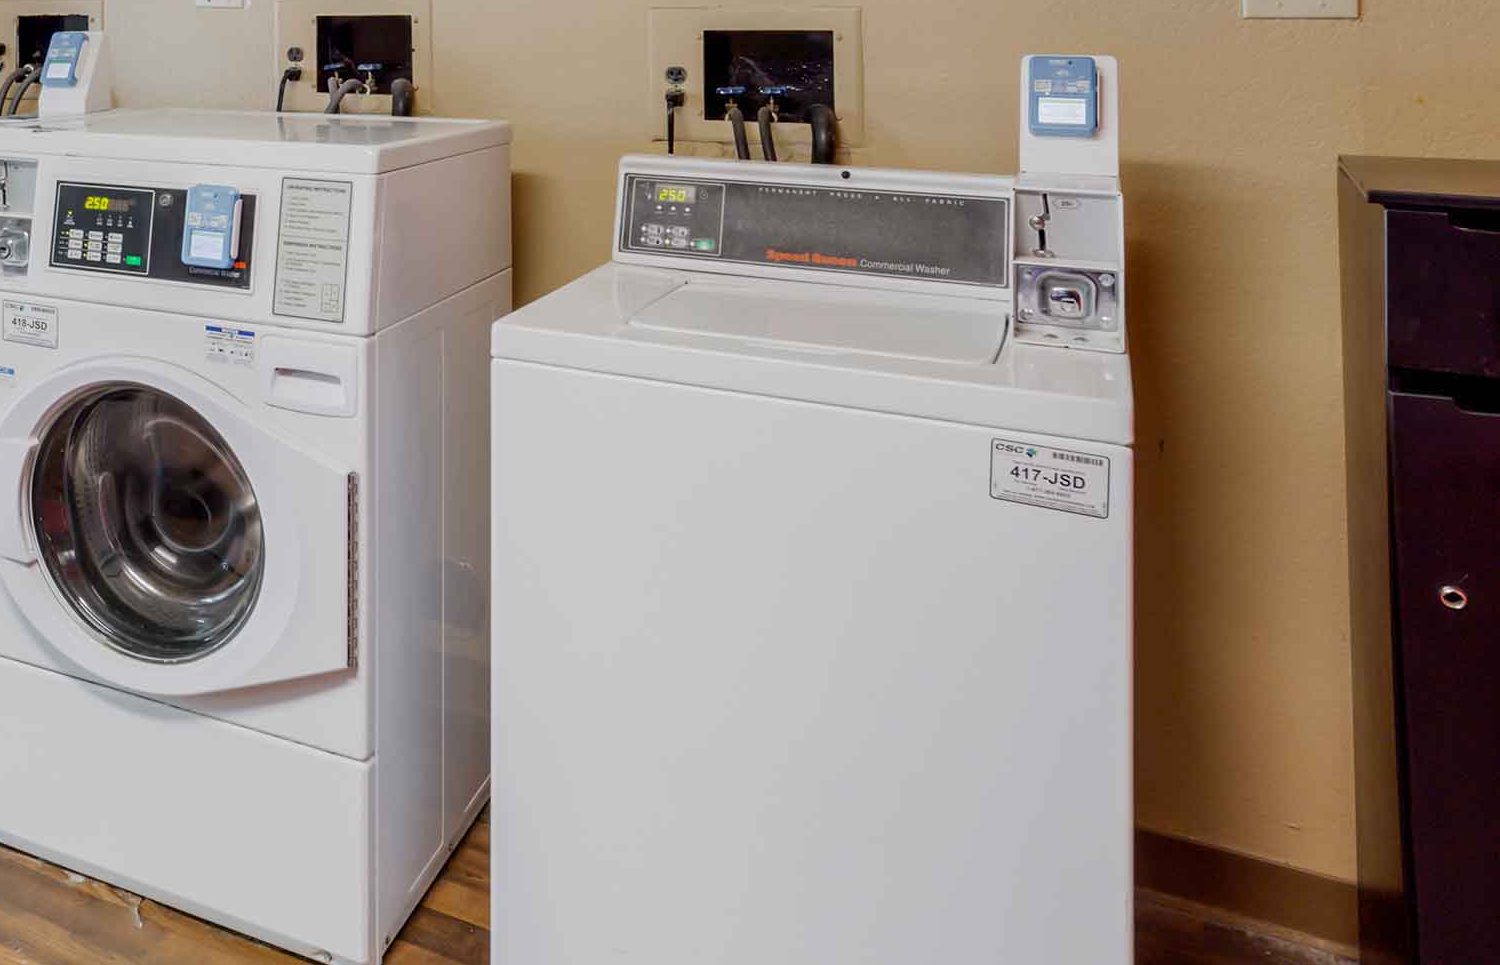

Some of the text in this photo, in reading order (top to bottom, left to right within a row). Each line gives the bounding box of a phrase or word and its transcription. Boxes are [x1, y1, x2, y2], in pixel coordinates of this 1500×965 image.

[659, 187, 686, 202] 250
[84, 196, 109, 210] 250
[859, 259, 951, 276] Commercial Washer
[11, 317, 49, 331] 418-JSD
[995, 443, 1026, 454] CSC
[1010, 465, 1086, 490] 417-JSD
